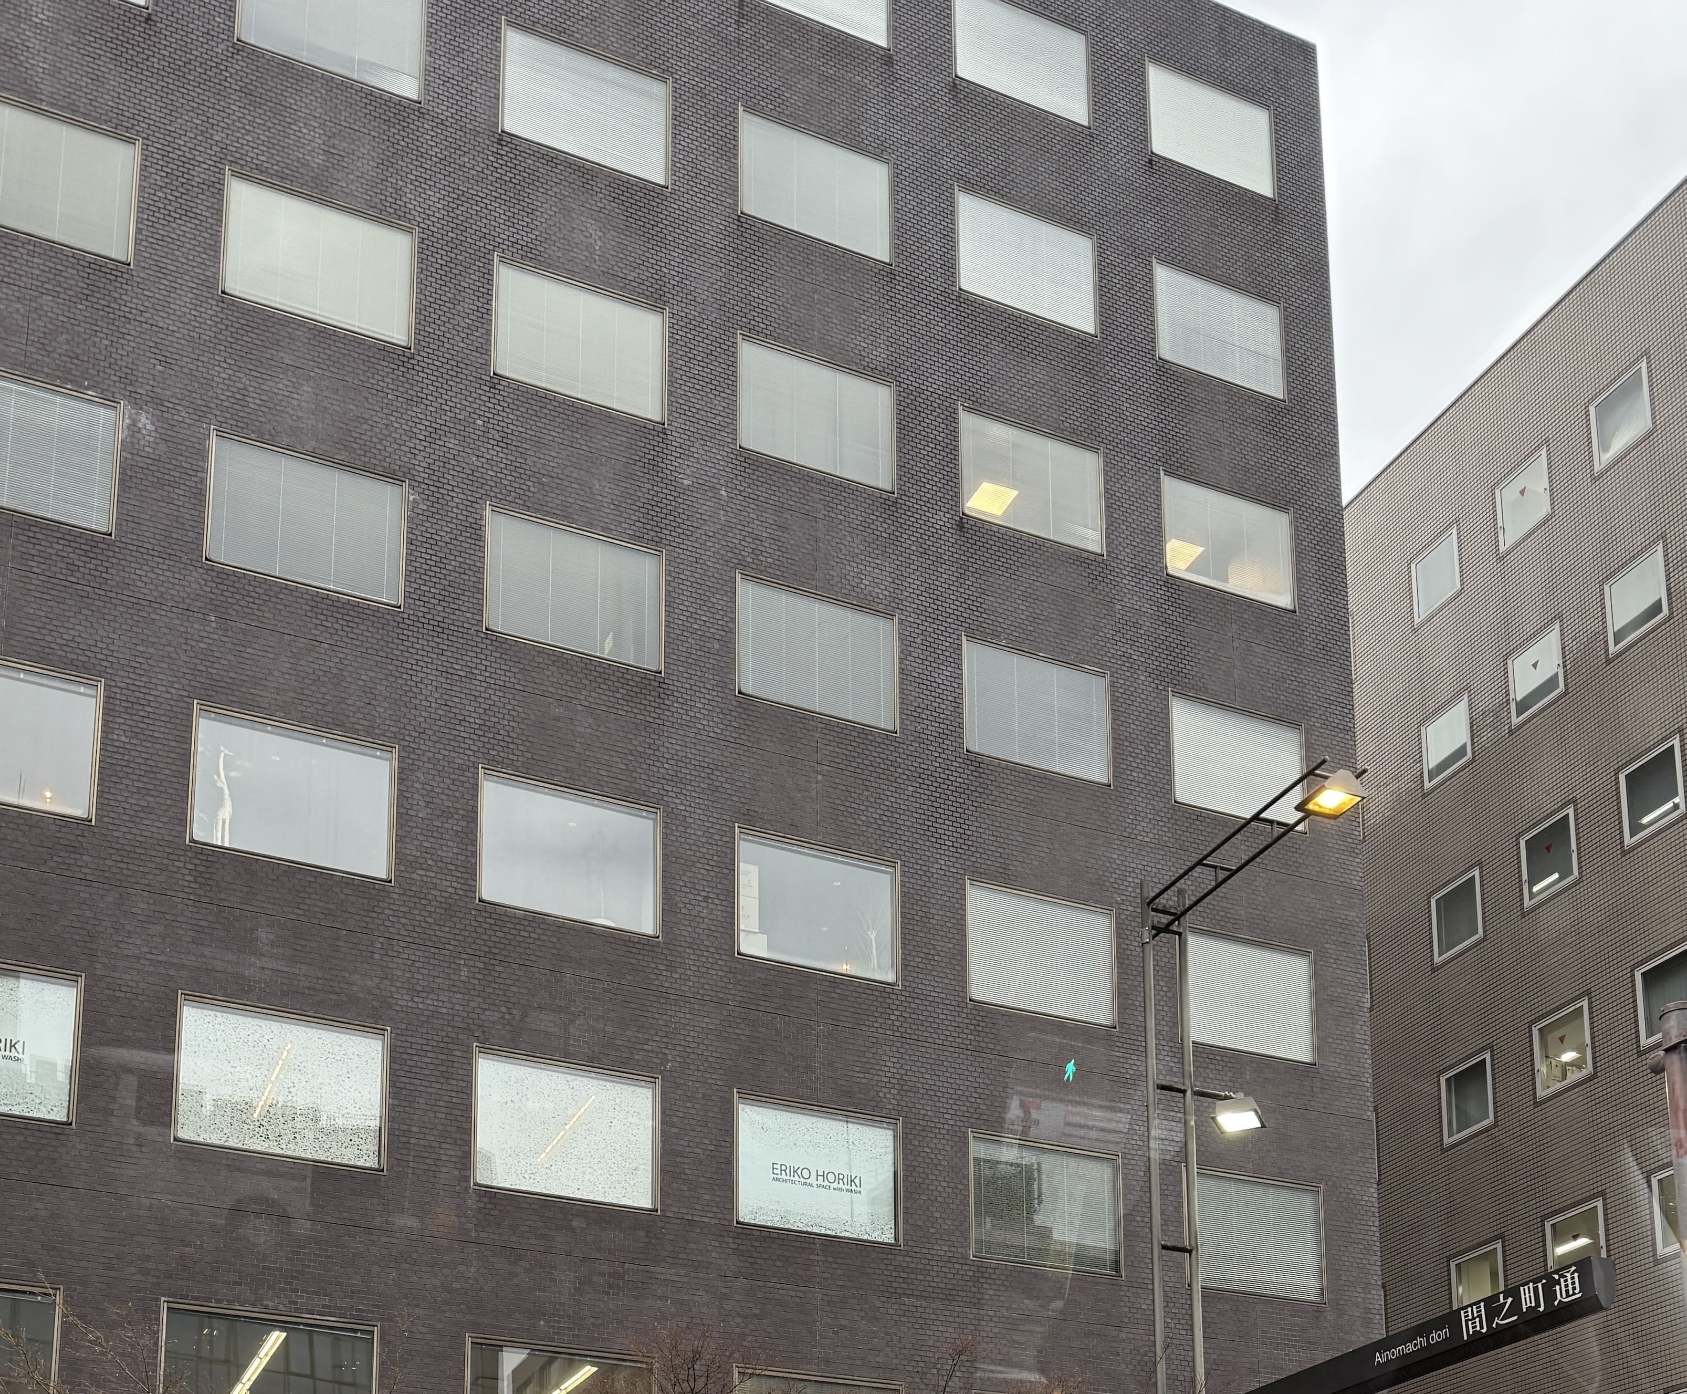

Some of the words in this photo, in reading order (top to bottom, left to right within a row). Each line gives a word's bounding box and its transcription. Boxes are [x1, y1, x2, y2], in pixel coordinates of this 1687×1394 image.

[772, 1162, 811, 1180] ERIKO
[816, 1169, 862, 1188] HORIKI
[772, 1176, 814, 1188] ARCHITECTURAL
[815, 1183, 831, 1191] SPACE
[1460, 1266, 1583, 1341] 間之町通
[1375, 1334, 1427, 1365] Ainomachi
[1430, 1325, 1450, 1345] dori
